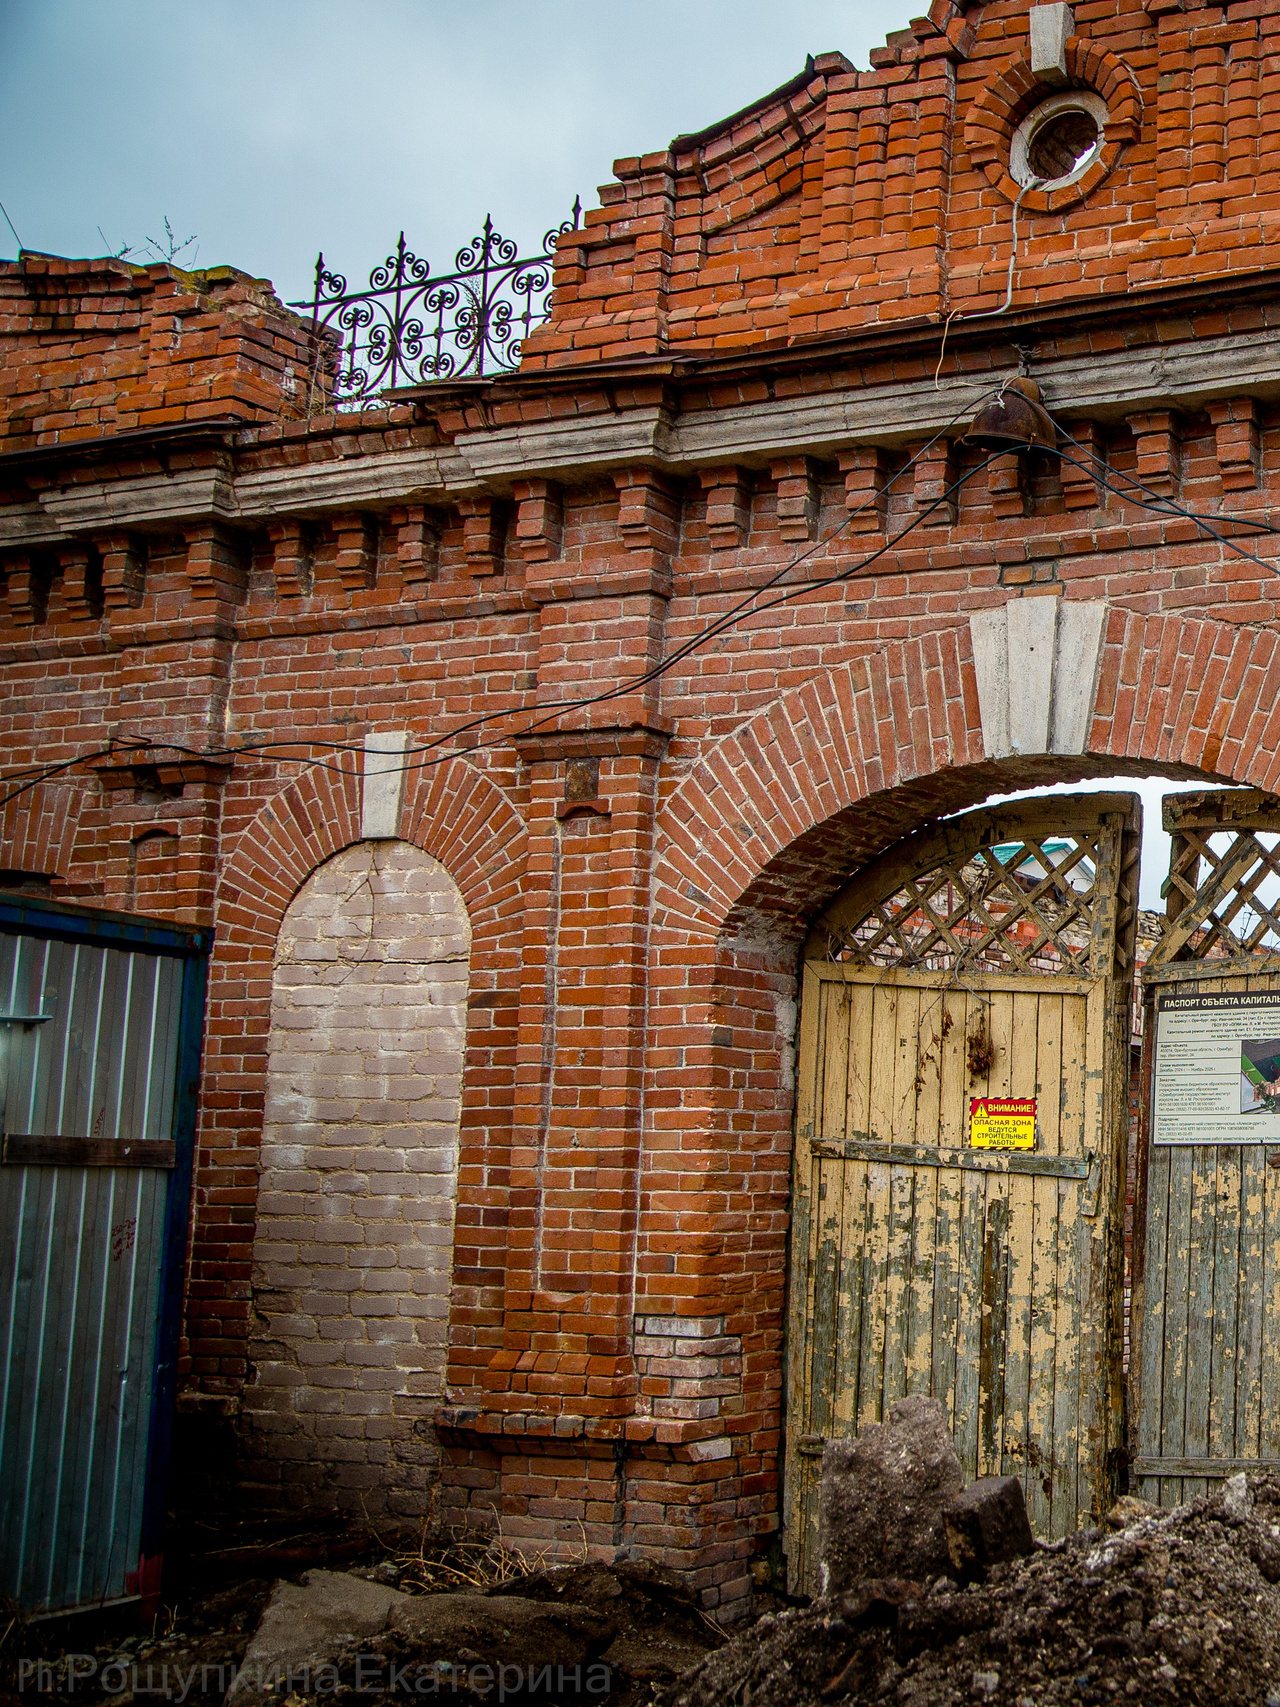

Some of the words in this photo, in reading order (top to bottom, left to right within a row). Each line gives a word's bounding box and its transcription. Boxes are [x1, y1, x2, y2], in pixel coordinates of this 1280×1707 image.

[1164, 998, 1200, 1008] ПАСПОРТ
[1202, 997, 1239, 1006] ОБЪЕКТА
[988, 1104, 1034, 1113] ВНИМАНИЕ!
